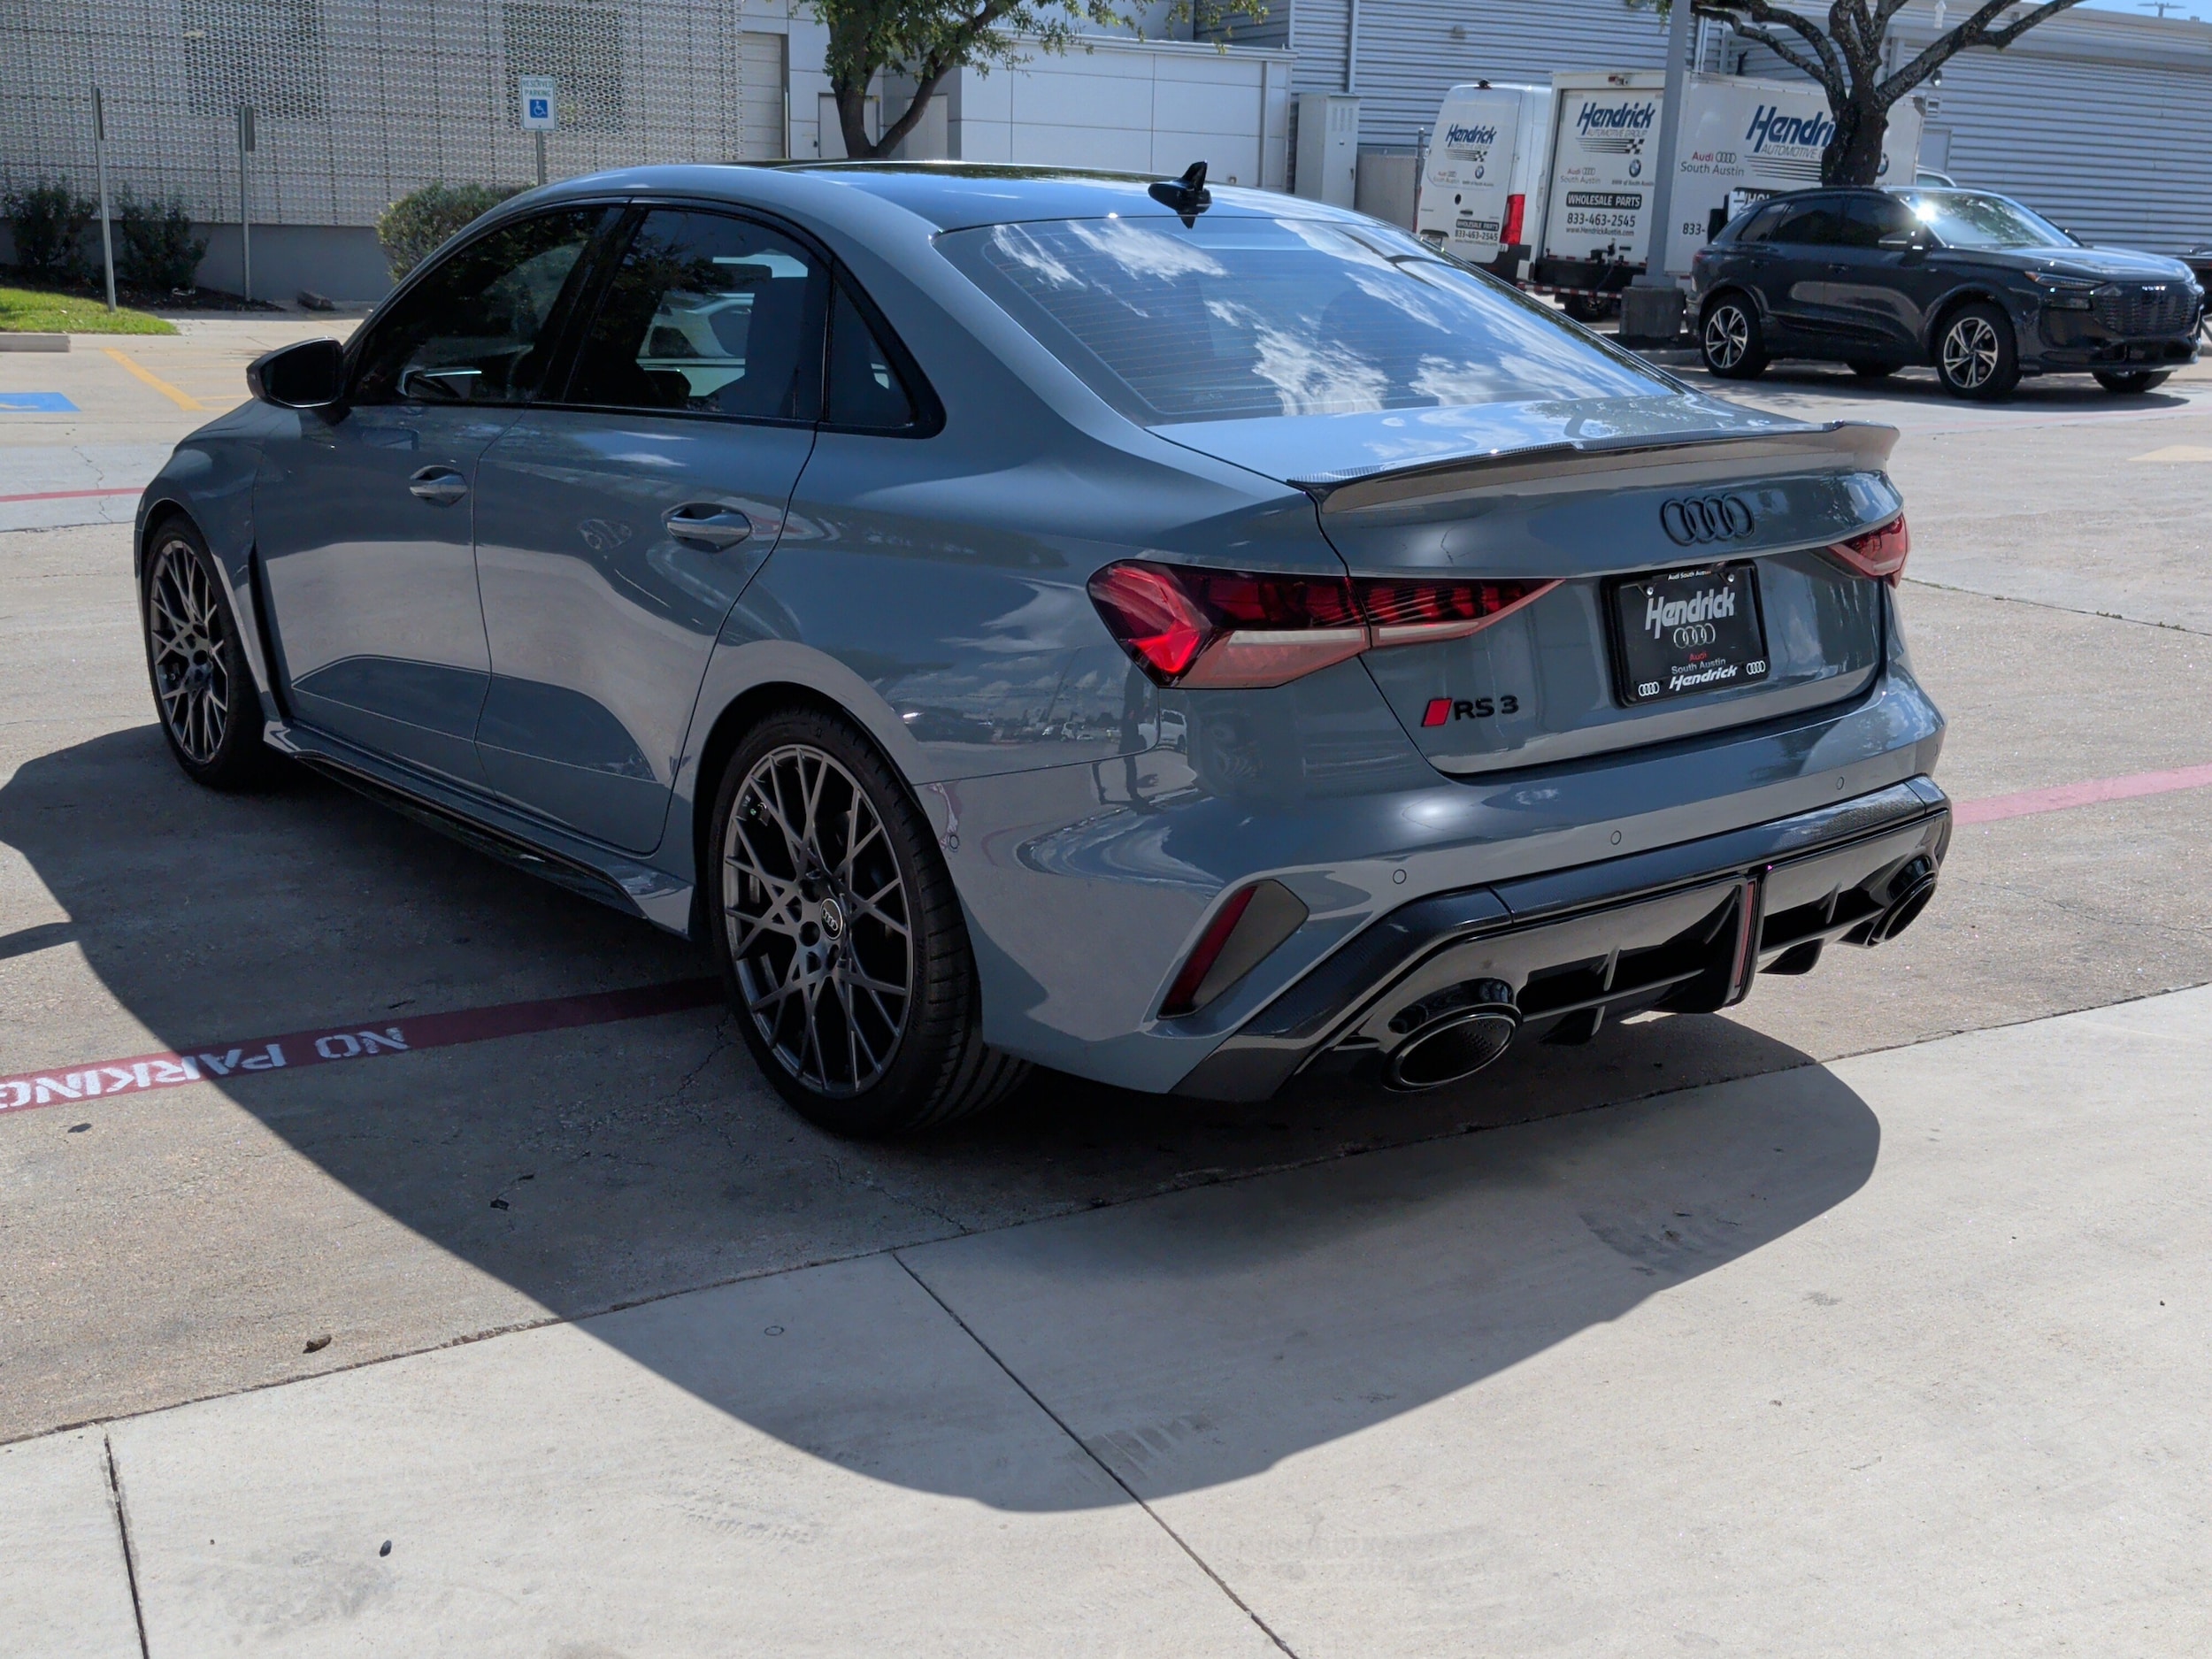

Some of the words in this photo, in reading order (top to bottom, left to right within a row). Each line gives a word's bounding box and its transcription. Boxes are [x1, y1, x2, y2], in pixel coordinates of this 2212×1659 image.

[1576, 102, 1656, 136] Hendrick
[1745, 104, 1836, 153] Hendri
[1445, 123, 1497, 148] Hendrick
[1692, 151, 1714, 162] Audi
[1760, 144, 1817, 158] AUTOMOTIVE
[1560, 175, 1579, 184] South
[1681, 161, 1710, 174] South
[1712, 165, 1745, 177] Austin
[1568, 194, 1612, 206] WHOLESALE
[1616, 196, 1640, 207] PARTS
[1567, 212, 1636, 227] 833-463-2545
[1645, 586, 1736, 640] Hendrick
[1671, 662, 1697, 674] South
[1699, 657, 1726, 670] Austin
[1688, 651, 1708, 662] Audi
[1669, 664, 1738, 691] Hendrick
[1454, 697, 1495, 721] RS
[1500, 695, 1519, 715] 3
[315, 1025, 411, 1058] NO
[0, 1042, 288, 1110] PARKING
